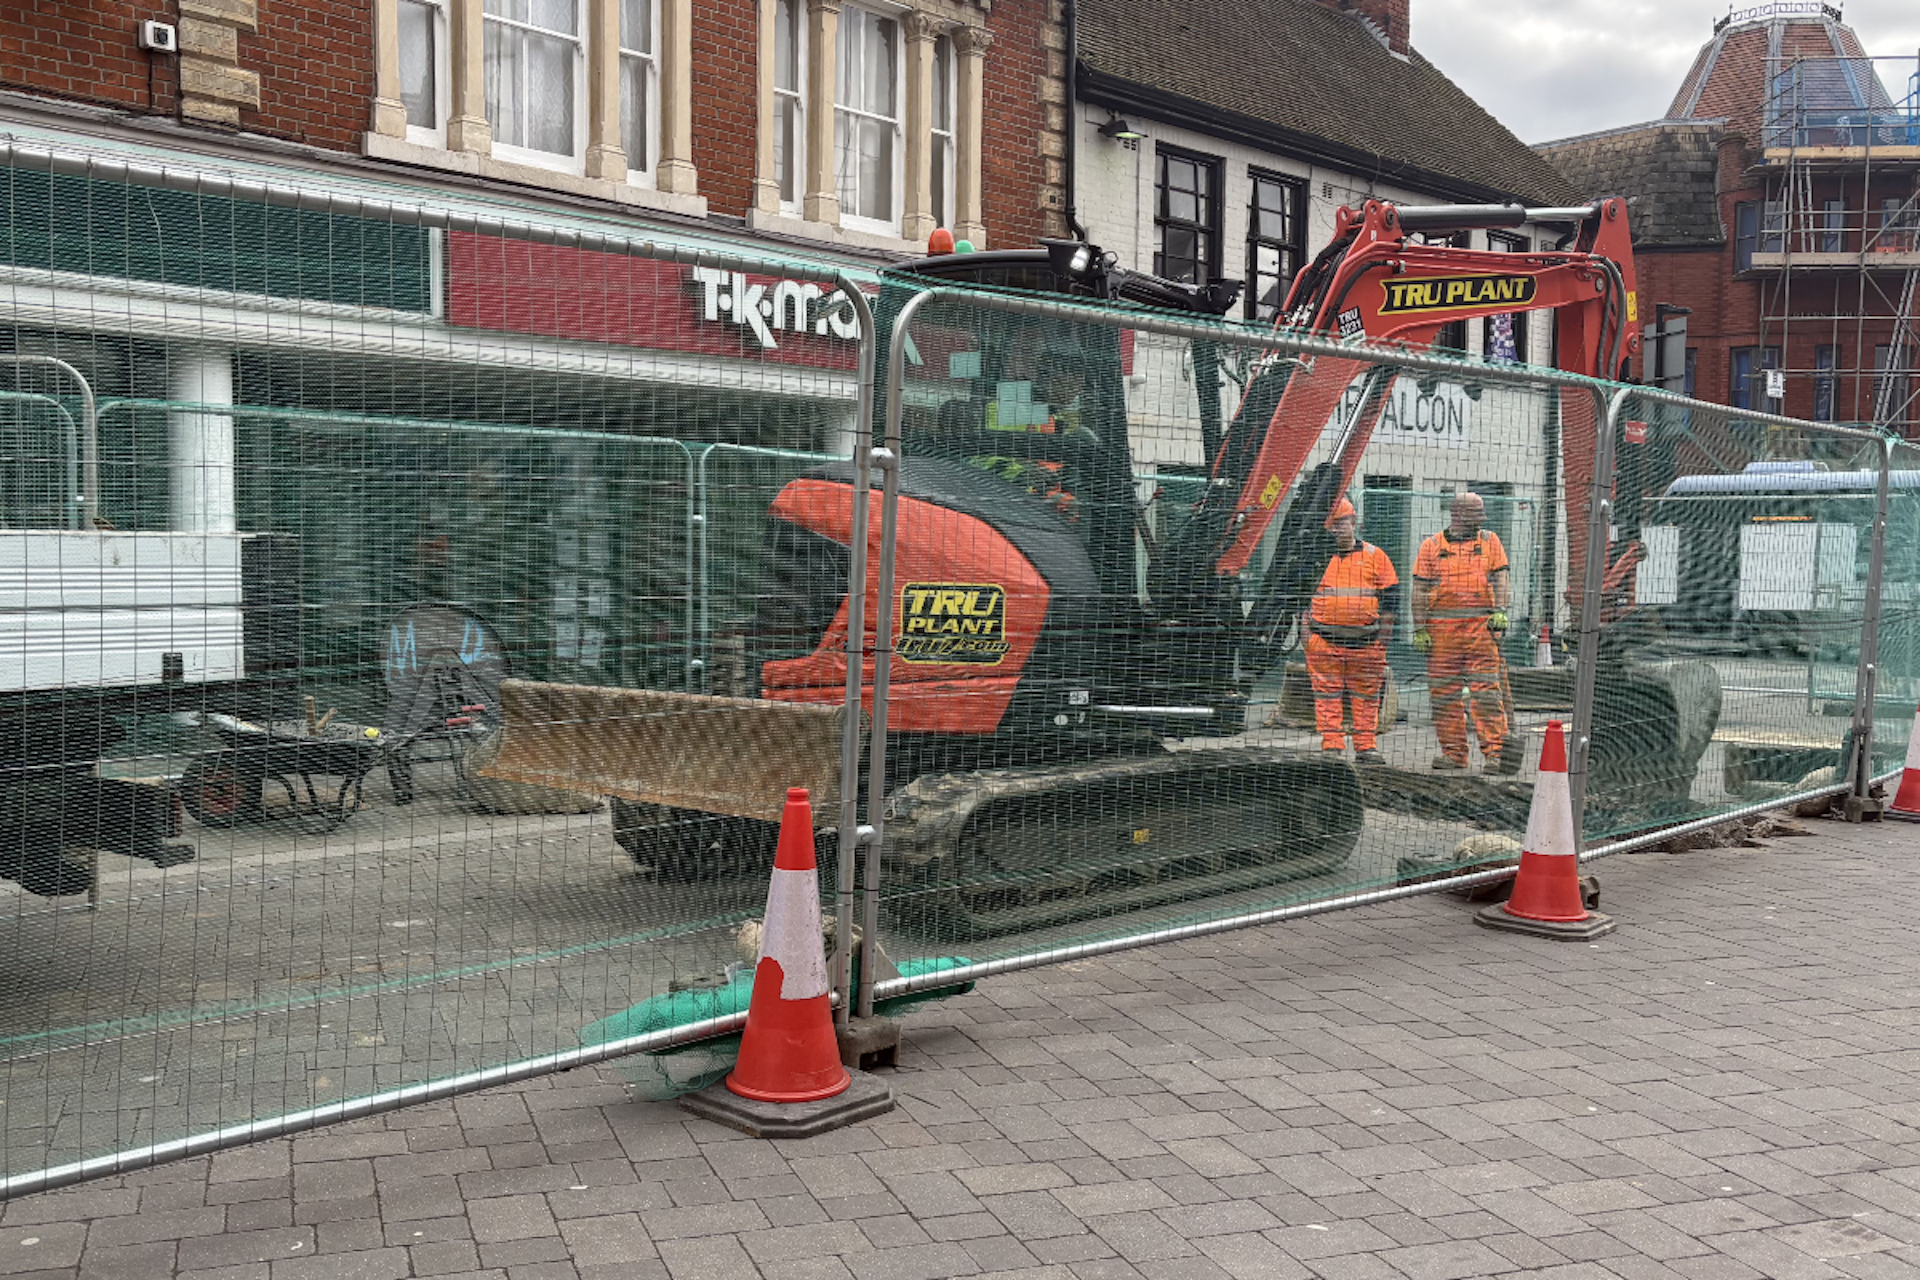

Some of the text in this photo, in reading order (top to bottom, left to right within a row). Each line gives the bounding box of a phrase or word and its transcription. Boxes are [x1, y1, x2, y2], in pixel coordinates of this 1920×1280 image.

[1391, 277, 1529, 308] TRU PLANT
[1338, 307, 1358, 325] TRU
[1381, 391, 1463, 436] ALCON
[908, 590, 1000, 616] TRU
[907, 617, 1000, 635] PLANT
